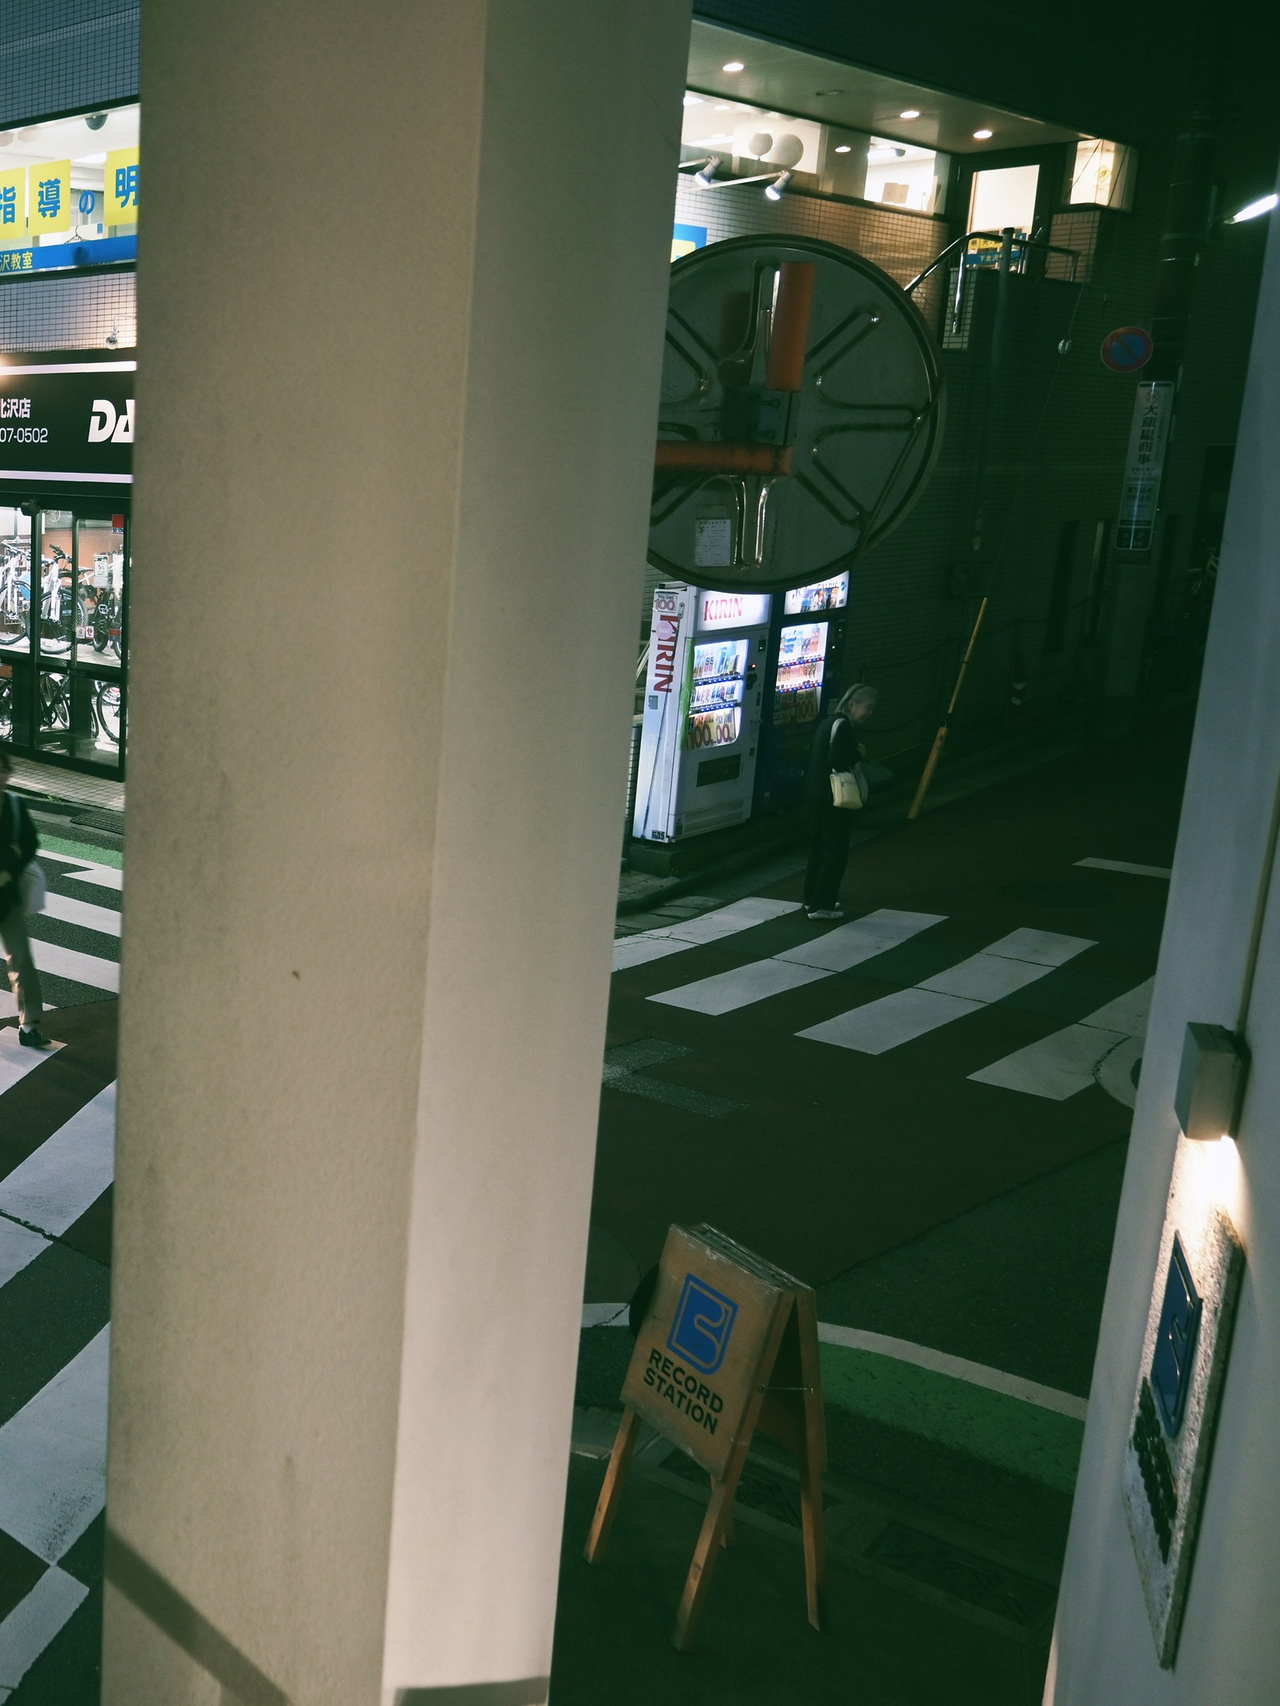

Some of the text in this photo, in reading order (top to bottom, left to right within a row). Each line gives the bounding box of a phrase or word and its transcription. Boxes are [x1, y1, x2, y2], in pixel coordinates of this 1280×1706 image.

[704, 596, 743, 621] KIRIN
[643, 1368, 718, 1435] STATION
[649, 1348, 724, 1414] RECORD
